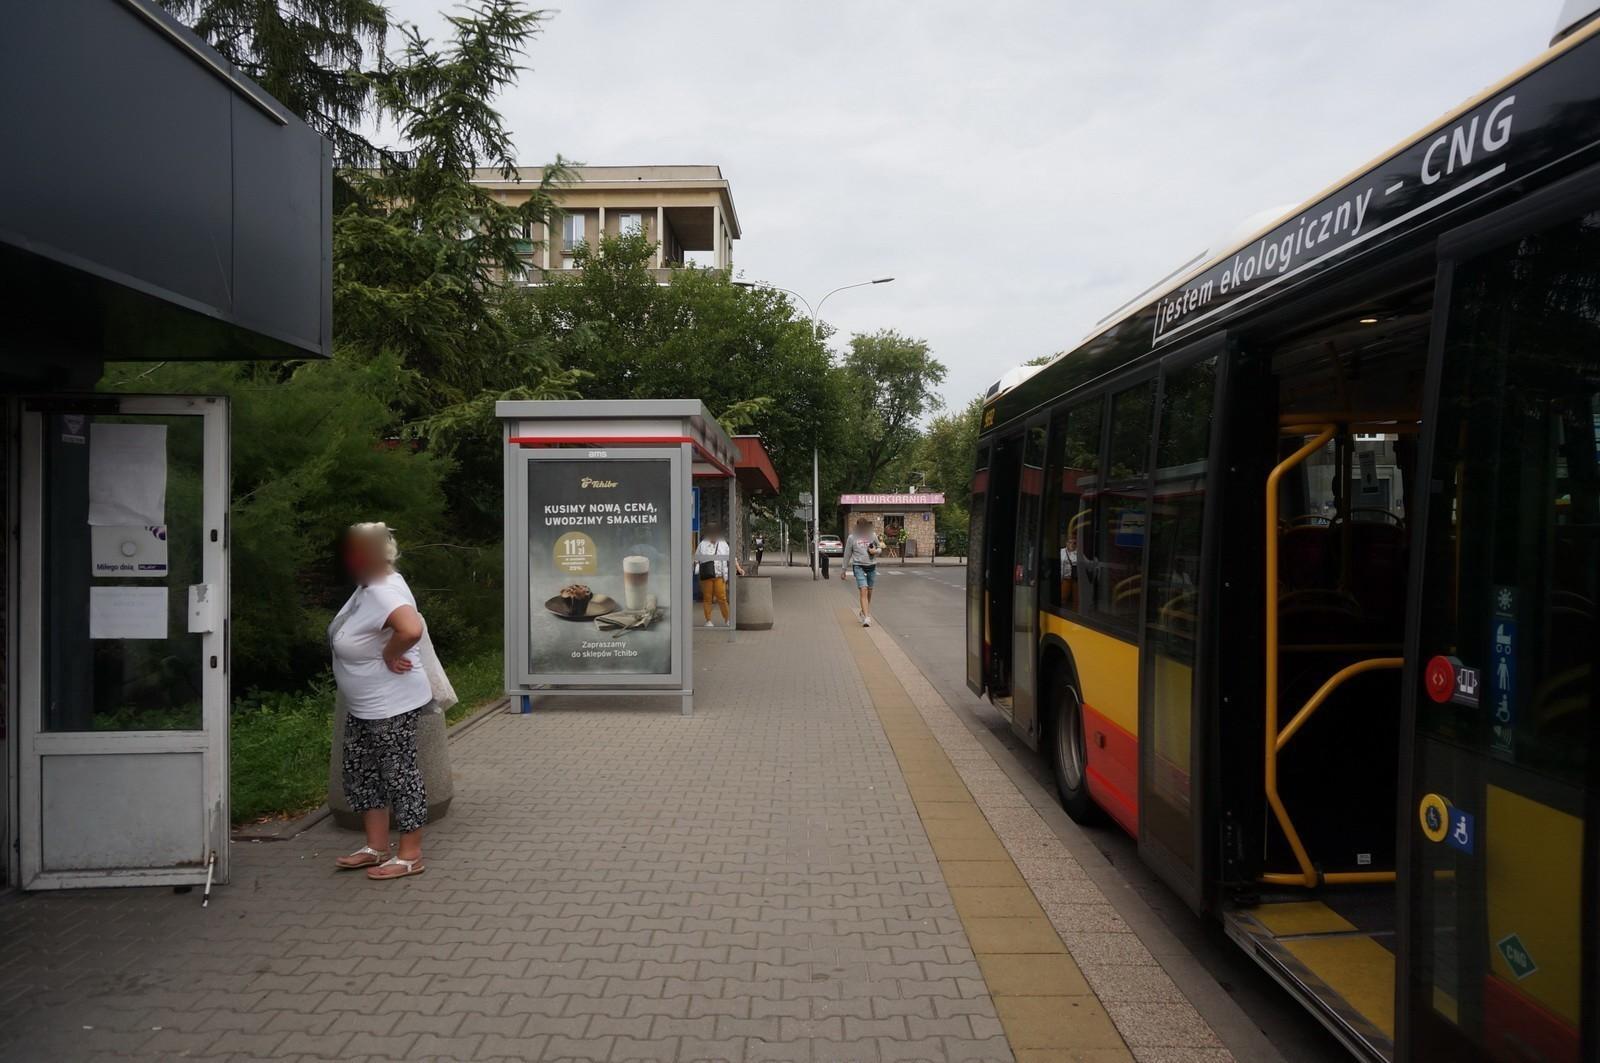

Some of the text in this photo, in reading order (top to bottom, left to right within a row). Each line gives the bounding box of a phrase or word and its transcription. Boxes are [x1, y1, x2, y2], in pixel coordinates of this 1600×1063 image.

[1159, 279, 1213, 334] jestem
[1220, 187, 1374, 295] ekologiczny
[1420, 95, 1516, 186] CNG
[591, 480, 618, 488] Tchibo
[544, 502, 658, 514] KUSIMY NOWĄ CENĄ,
[545, 515, 657, 526] UWODZIMY SMAKIEM
[582, 641, 626, 649] Zapraszamy
[582, 650, 611, 658] sklepów
[1506, 944, 1528, 969] CNG
